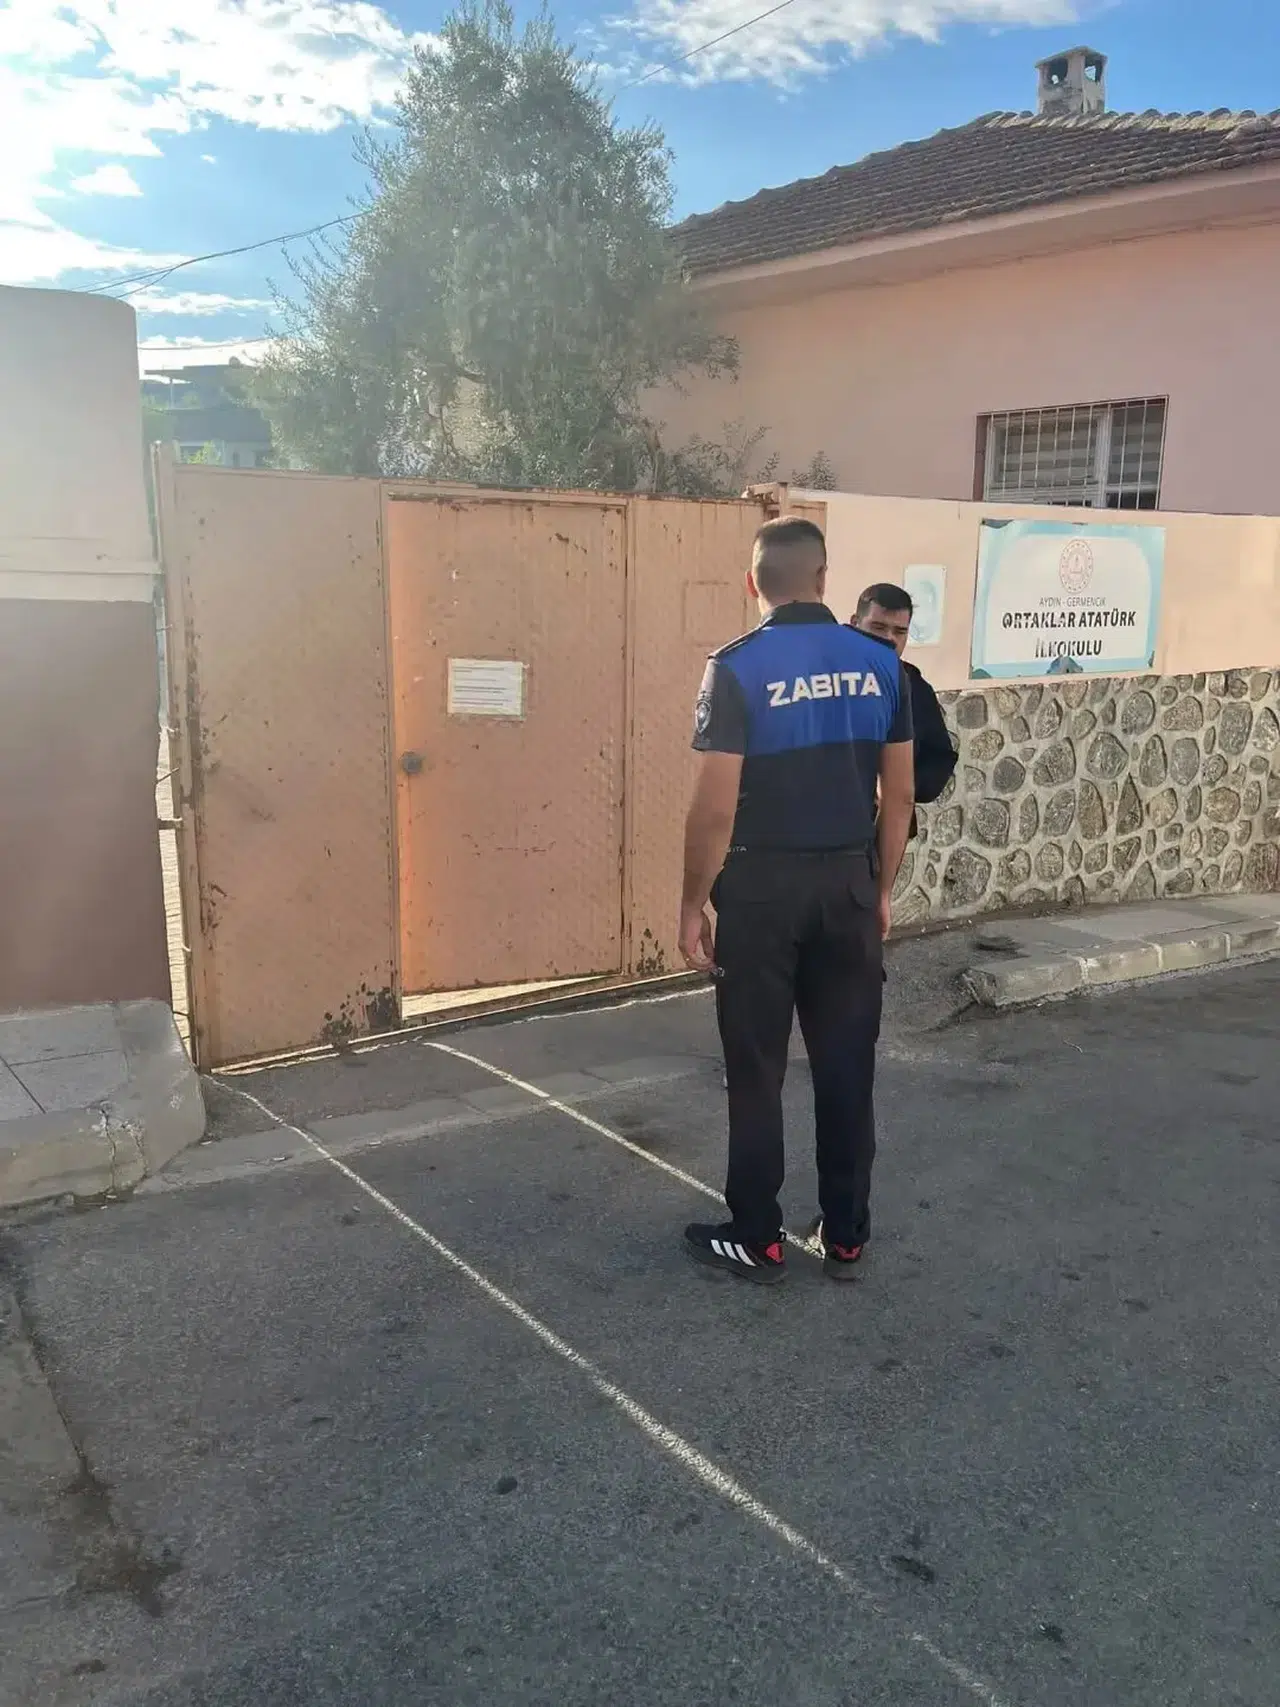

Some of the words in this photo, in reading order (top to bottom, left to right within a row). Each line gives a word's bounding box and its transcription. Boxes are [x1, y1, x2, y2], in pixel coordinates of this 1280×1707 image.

[1039, 597, 1061, 607] AYDIN
[1002, 611, 1076, 629] ORTAKLAR
[1078, 608, 1136, 628] ATATÜRK
[1035, 638, 1102, 658] İLKOKULU
[766, 672, 882, 708] ZABITA
